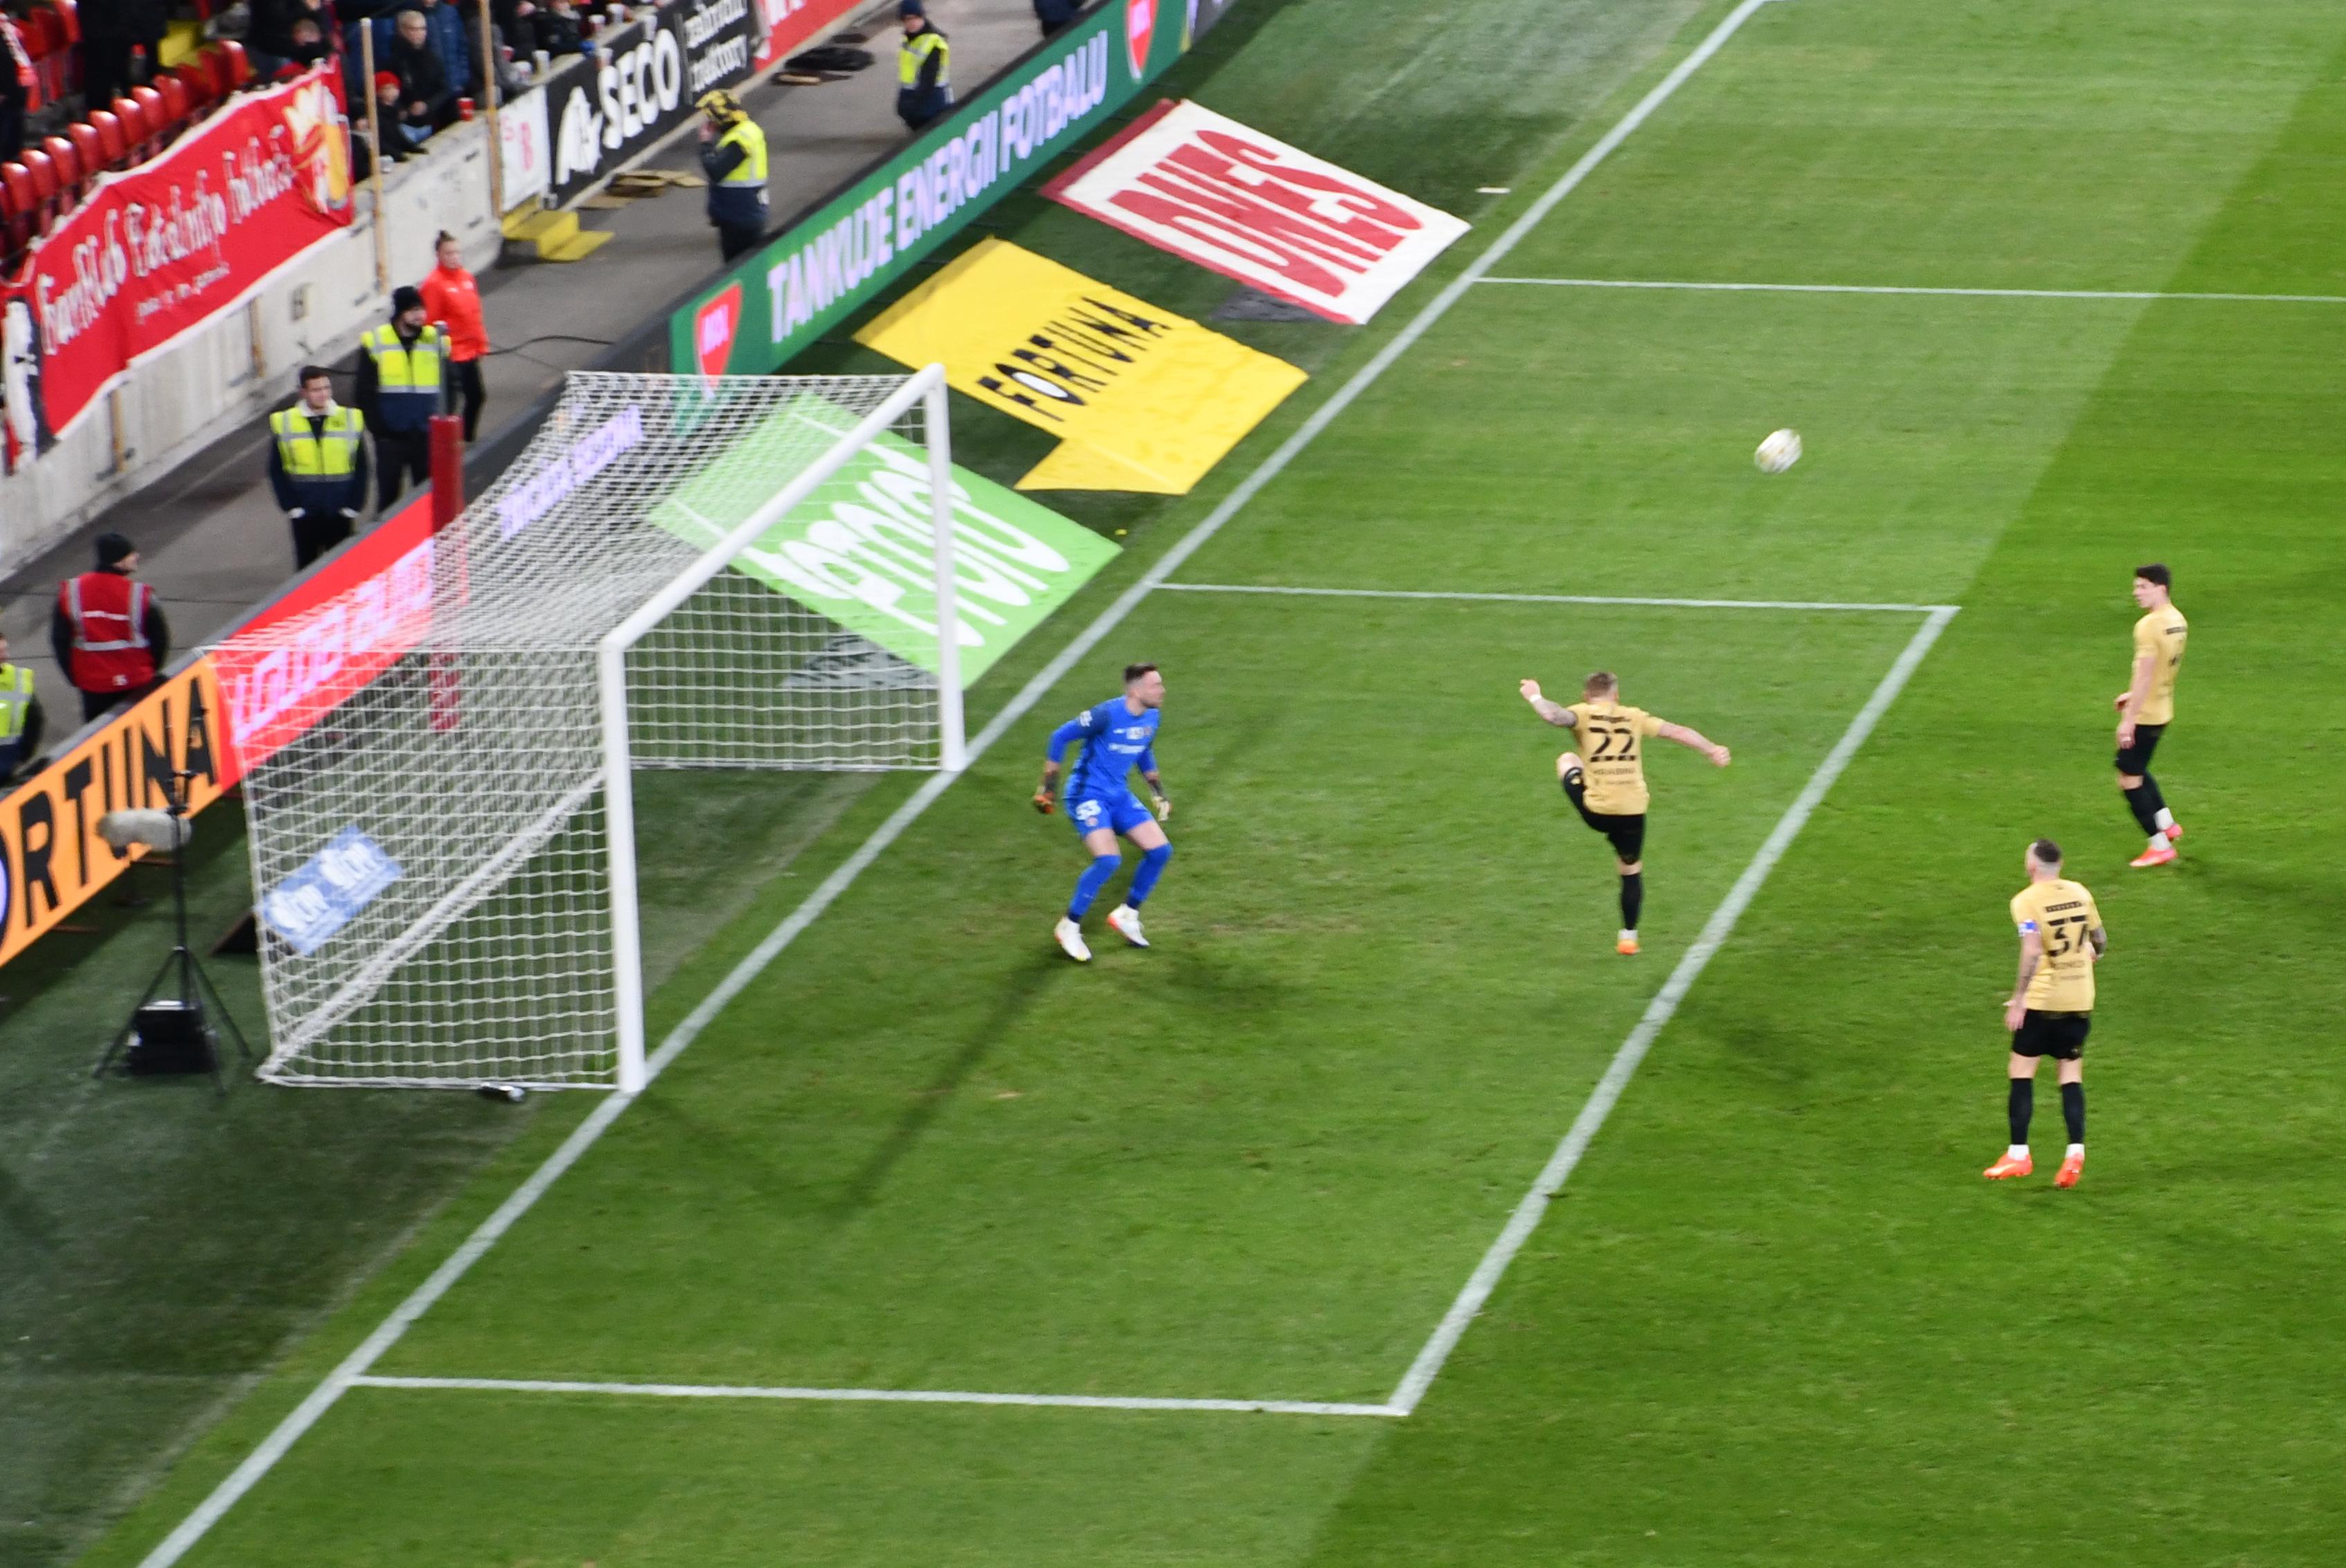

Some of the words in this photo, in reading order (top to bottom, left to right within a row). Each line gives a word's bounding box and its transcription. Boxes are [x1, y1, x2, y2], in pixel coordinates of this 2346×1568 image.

[767, 186, 894, 343] TANKUJE
[896, 111, 998, 251] ENERGII
[1000, 30, 1108, 174] FOTBALU
[1108, 129, 1424, 297] DNES
[977, 296, 1174, 422] FORTUNA
[1589, 727, 1636, 762] 22
[2048, 914, 2088, 957] 37
